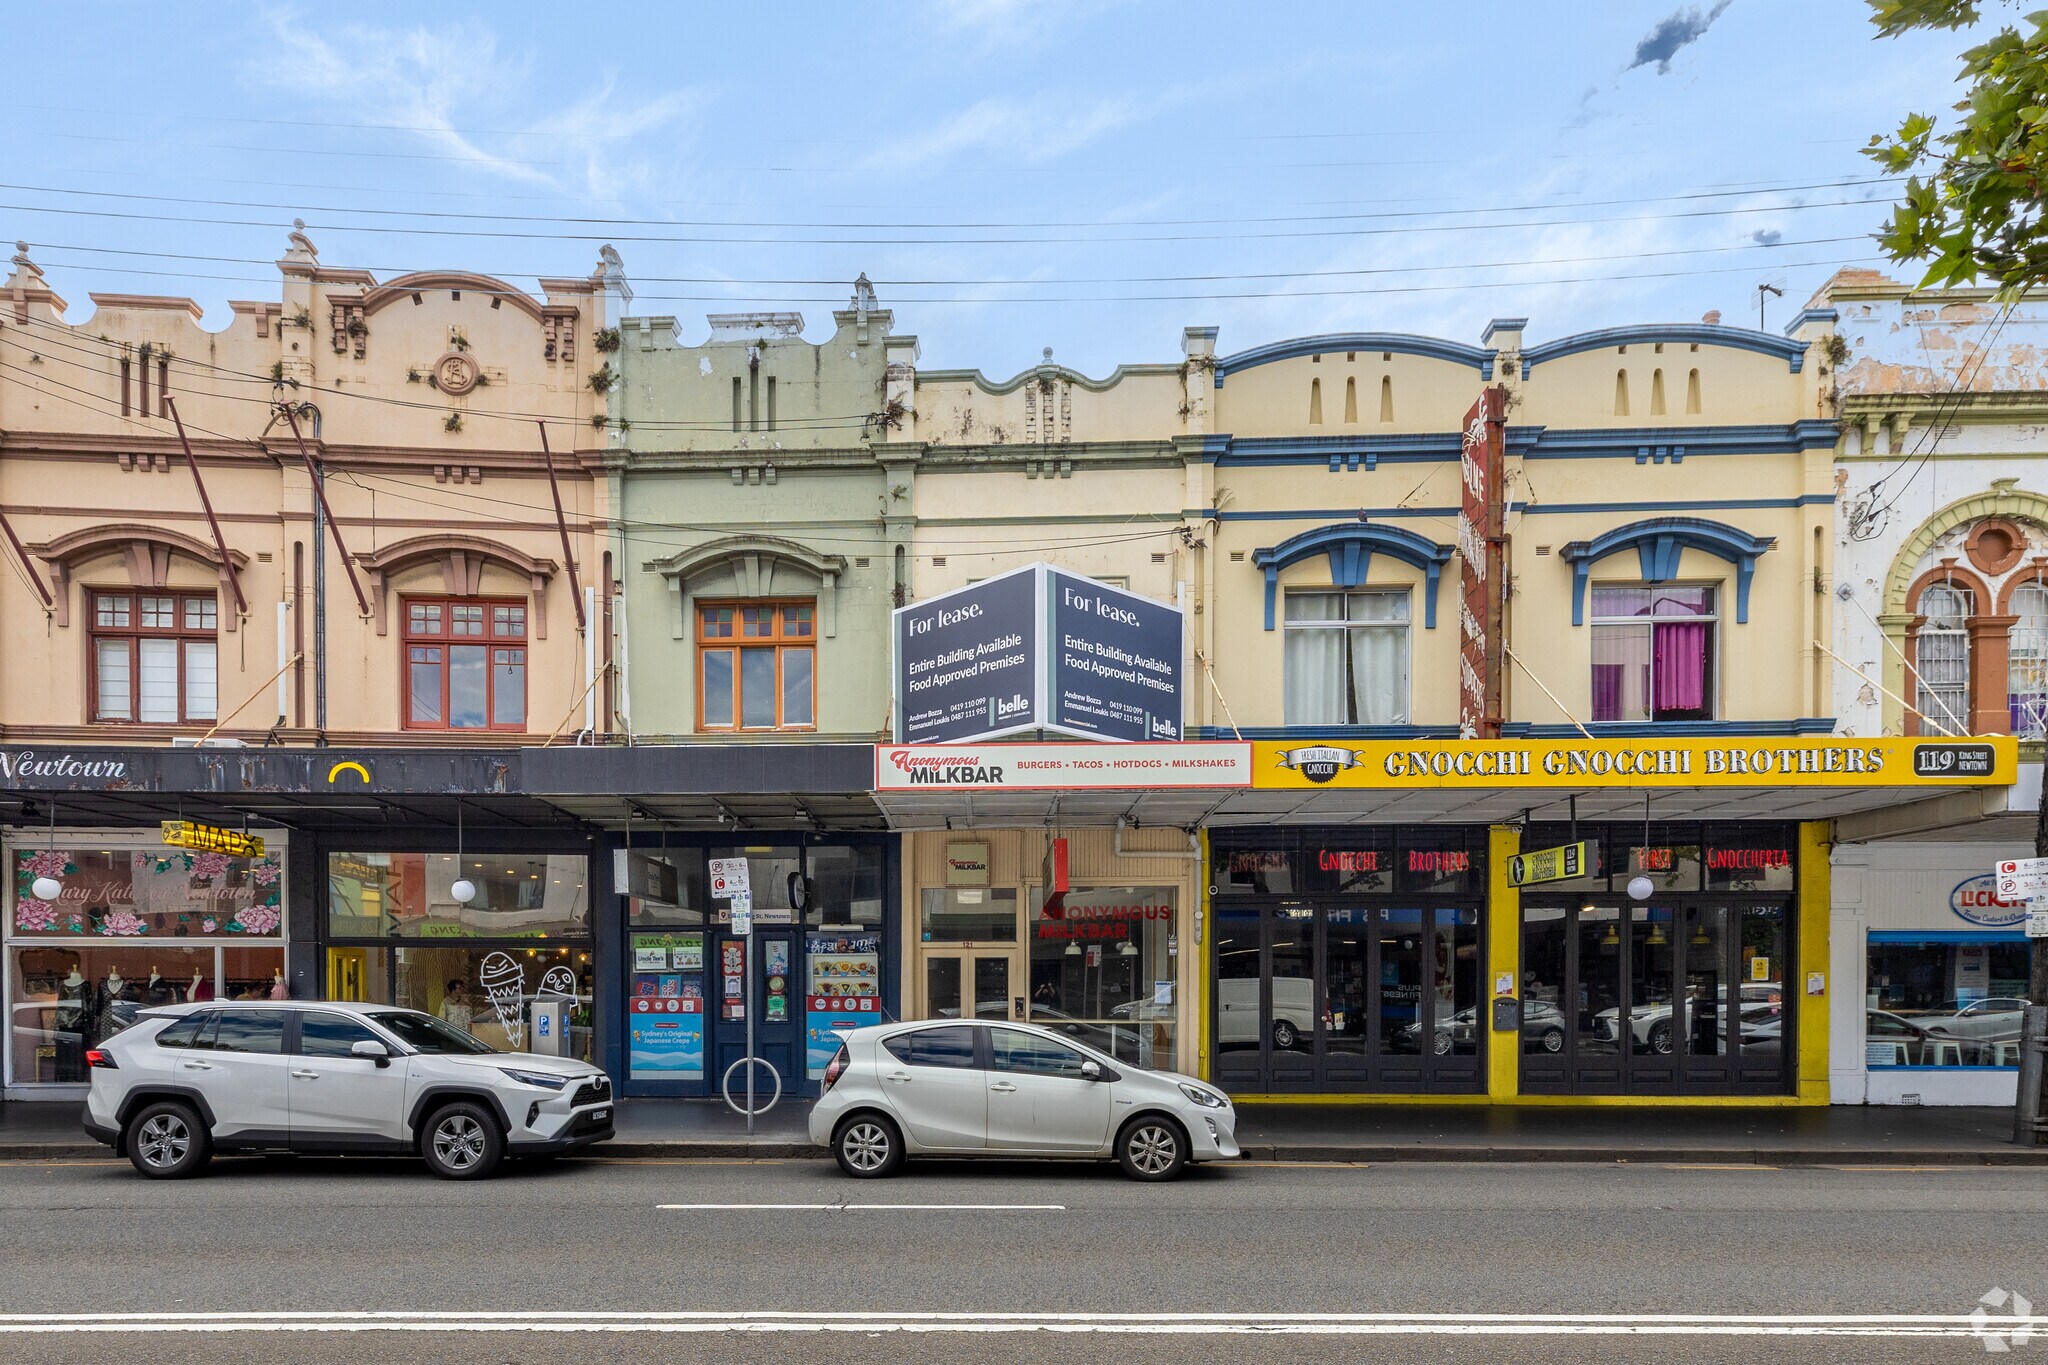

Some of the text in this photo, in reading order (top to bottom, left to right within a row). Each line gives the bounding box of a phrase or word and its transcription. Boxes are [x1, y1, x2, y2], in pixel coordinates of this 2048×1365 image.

[1065, 588, 1140, 627] For lease.
[909, 602, 984, 636] For lease.
[909, 634, 1022, 674] Entire Building Available
[1065, 634, 1172, 675] Entire Building Available
[909, 652, 1024, 692] Food Approved Premises
[1065, 653, 1174, 694] Food Approved Premises
[909, 697, 986, 722] Andrew Bozza 0419 110 099
[998, 694, 1029, 714] belle
[1064, 690, 1085, 701] Andrew
[1086, 695, 1102, 705] Bozza
[1110, 701, 1122, 710] 0419
[1123, 705, 1132, 713] 110
[1064, 701, 1092, 712] Emmanuel
[1110, 710, 1122, 719] 0487
[1124, 714, 1132, 722] 111
[1133, 716, 1143, 724] 955
[909, 720, 933, 731] Emmanuel
[951, 712, 964, 721] 0487
[965, 710, 975, 718] 111
[976, 706, 987, 715] 955
[1152, 717, 1177, 736] belle
[0, 751, 126, 778] Newtown
[890, 750, 980, 772] Anonymous
[1017, 759, 1236, 769] BURGERS TACOS HOTDOGS MILKSHAKES
[1301, 749, 1340, 761] FRESH ITALIAN
[1384, 748, 1884, 776] GNOCCHI GNOCCHI BROTHERS
[1918, 750, 1955, 771] 119
[1959, 761, 1988, 770] NEWTOWN
[910, 766, 1004, 784] MILKBAR
[1307, 763, 1333, 774] GNOCCHI
[1319, 849, 1378, 872] GNOCCHI
[1408, 850, 1469, 872] BROTHERS
[1708, 848, 1789, 869] GNOCCHERIA
[2005, 863, 2013, 872] C
[1964, 909, 1980, 920] Frozen
[1982, 914, 2003, 922] Custard
[1039, 924, 1128, 938] MILKBAR
[541, 1016, 547, 1024] P
